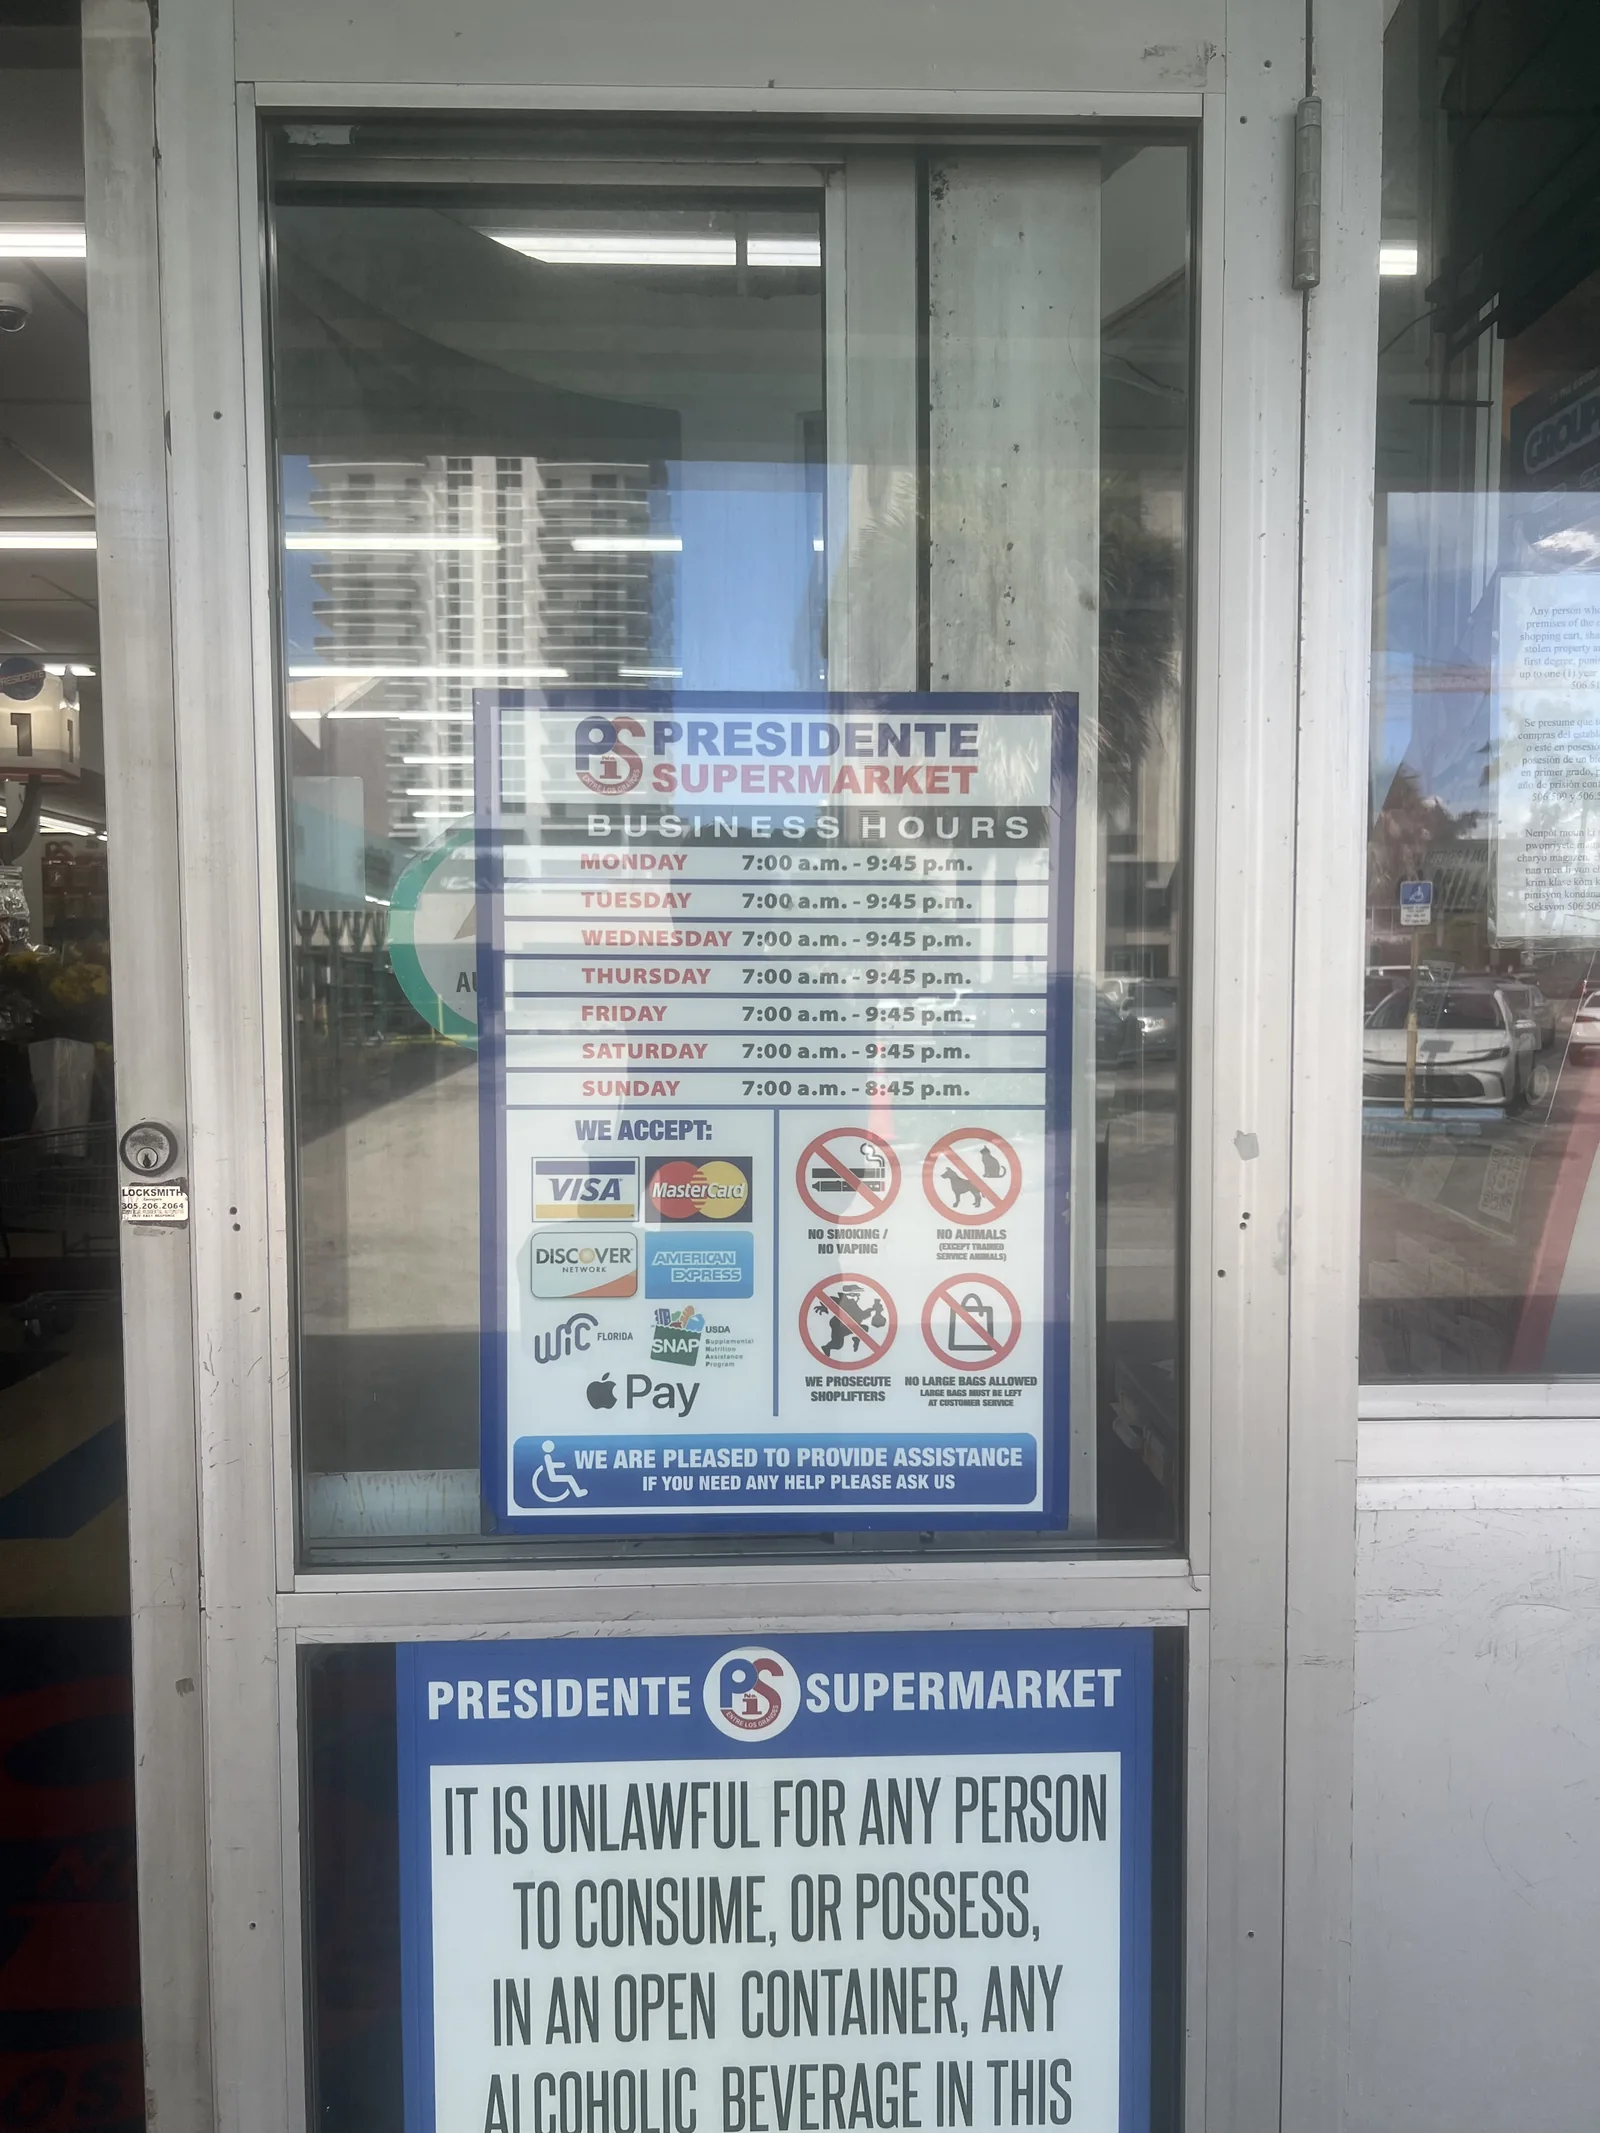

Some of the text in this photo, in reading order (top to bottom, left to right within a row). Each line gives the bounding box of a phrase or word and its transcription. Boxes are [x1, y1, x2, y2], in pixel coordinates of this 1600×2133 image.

[1530, 607, 1580, 616] Any person
[1526, 620, 1566, 630] premises
[1520, 632, 1561, 642] shopping
[1524, 644, 1590, 654] stolen property
[1524, 657, 1576, 667] first degree,
[1579, 671, 1598, 680] year
[1538, 720, 1575, 728] presume
[10, 712, 32, 756] 1
[653, 721, 980, 758] PRESIDENTE
[1522, 756, 1560, 766] posesión
[652, 763, 978, 795] SUPERMARKET
[1534, 768, 1563, 778] primer
[1550, 780, 1580, 790] prisión
[588, 814, 1029, 840] BUSINESS HOURS
[580, 854, 973, 875] MONDAY 7:00 a.m. 9:45 p.m.
[1524, 890, 1562, 900] pinisyon
[581, 892, 972, 913] TUESDAY 7:00 a.m. 9:45 p.m.
[1528, 902, 1564, 913] Seksyon
[581, 930, 972, 951] WEDNESDAY 7:00 a.m. 9:45 p.m.
[581, 968, 972, 989] THURSDAY 7:00 a.m. 9:45 p.m.
[582, 1006, 970, 1026] FRIDAY 7:00 a.m. 9:45 p.m.
[582, 1043, 970, 1064] SATURDAY 7:00 a.m. 9:45 p.m.
[582, 1080, 970, 1100] SUNDAY 7:00 a.m. 8:45 p.m.
[575, 1120, 712, 1141] WE ACCEPT:
[122, 1188, 184, 1197] LOCKSMITH
[549, 1178, 622, 1201] VISA
[652, 1182, 746, 1200] MasterCard
[122, 1202, 184, 1210] 305.206.2064
[808, 1228, 880, 1240] NO SMOKING
[936, 1229, 1007, 1240] NO ANIMALS
[818, 1244, 878, 1254] NO VAPING
[939, 1243, 971, 1251] (EXCEPT
[536, 1248, 631, 1265] DISCOVER
[652, 1251, 736, 1266] AMERICAN
[562, 1266, 607, 1274] NETWORK
[671, 1268, 742, 1282] EXPRESS
[597, 1332, 634, 1341] FLORIDA
[705, 1326, 731, 1334] USDA
[652, 1338, 700, 1354] SNAP
[705, 1338, 754, 1346] Supplemental
[805, 1376, 892, 1387] WE PROSECUTE
[905, 1376, 1038, 1386] NO LARGE BAGS ALLOWED
[626, 1374, 700, 1418] Pay
[811, 1391, 886, 1402] SHOPLIFTERS
[574, 1447, 1022, 1470] WE ARE PLEASED TO PROVIDE ASSISTANCE
[642, 1474, 956, 1491] IF YOU NEED ANY HELP PLEASE ASK US
[428, 1675, 692, 1721] PRESIDENTE
[806, 1668, 1122, 1715] SUPERMARKET
[726, 1711, 743, 1727] ENTRE
[758, 1704, 779, 1728] GRANDES
[444, 1773, 1108, 1857] IT IS UNLAWFUL FOR ANY PERSON
[513, 1870, 1041, 1950] TO CONSUME, OR POSSESS,
[492, 1964, 1064, 2048] IN AN OPEN CONTAINER, ANY
[483, 2057, 1073, 2133] ALCOHOLIC BEVERAGE IN THIS
